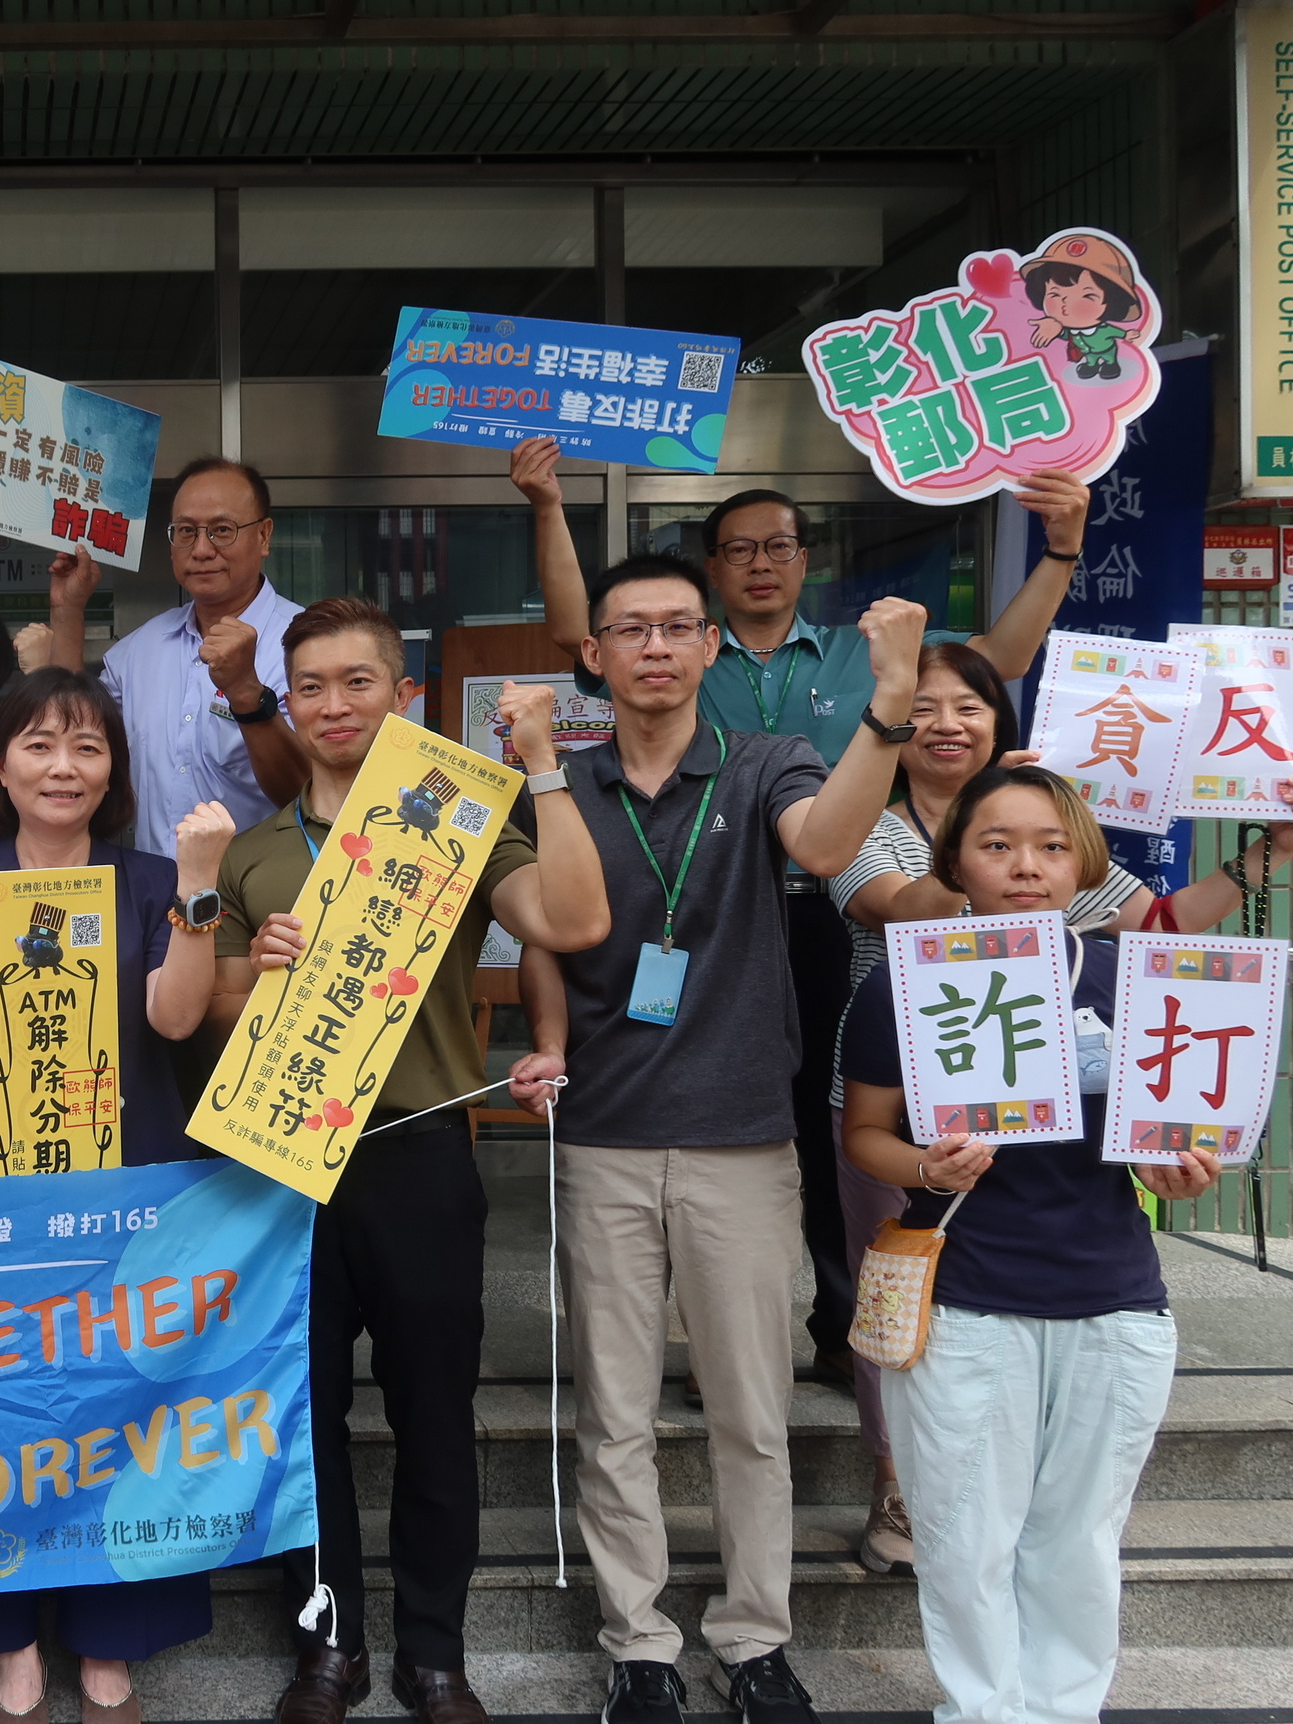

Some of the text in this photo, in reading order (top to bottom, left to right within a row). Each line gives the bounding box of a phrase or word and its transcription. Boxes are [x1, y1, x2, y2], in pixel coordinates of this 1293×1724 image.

[1275, 41, 1293, 395] SELF-SERVICE POST OFFICE
[407, 339, 669, 387] 幸福生活 FOREVER
[818, 300, 1007, 410] 彰化
[411, 384, 694, 436] 打詐反毒 TOGETHER
[875, 360, 1067, 482] 郵局
[1272, 446, 1293, 469] 員
[51, 498, 130, 557] 詐騙
[1075, 683, 1172, 778] 貪
[1201, 683, 1293, 763] 反
[12, 878, 102, 893] 臺灣彰化地方檢察署
[18, 988, 76, 1014] ATM
[268, 856, 422, 1137] 網戀都遇正緣符
[919, 970, 1047, 1089] 詐
[1136, 994, 1256, 1111] 打
[65, 1077, 113, 1095] 歐熊師
[222, 1120, 315, 1172] 反詐騙專線165
[47, 1206, 159, 1238] 撥打165
[35, 1509, 257, 1551] 臺灣彰化地方檢察署
[128, 1549, 164, 1560] District
[167, 1544, 227, 1556] Prosecutors
